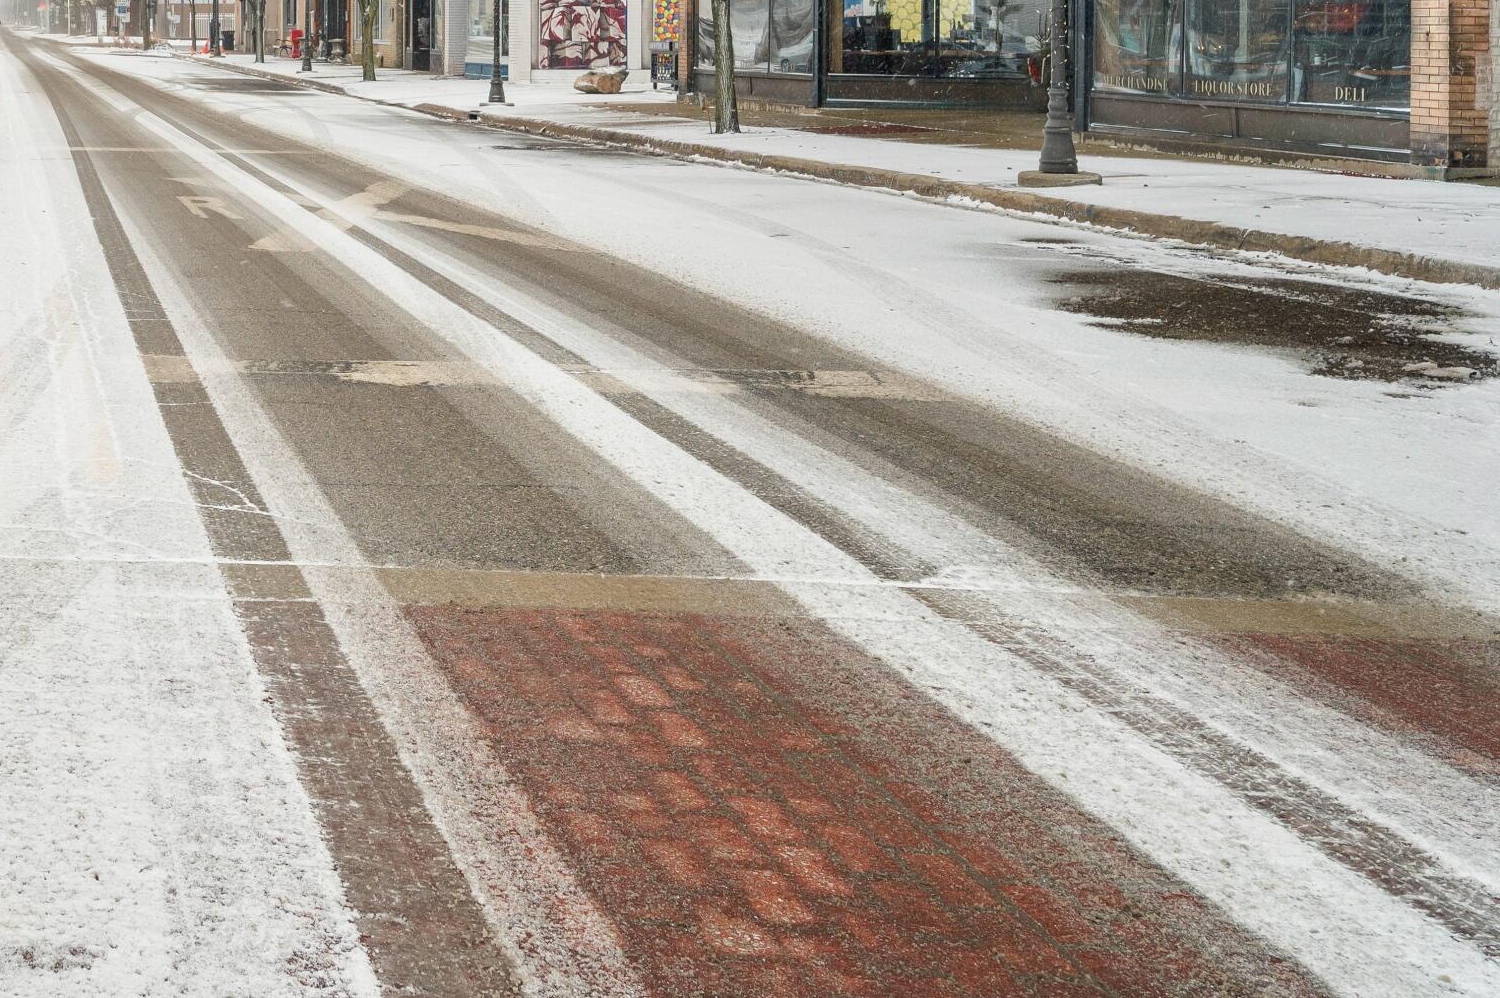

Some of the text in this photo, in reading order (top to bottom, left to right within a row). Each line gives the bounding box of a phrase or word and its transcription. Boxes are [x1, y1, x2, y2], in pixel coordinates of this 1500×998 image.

[1195, 79, 1272, 97] LIQUOR STORE
[1334, 86, 1365, 102] DELI
